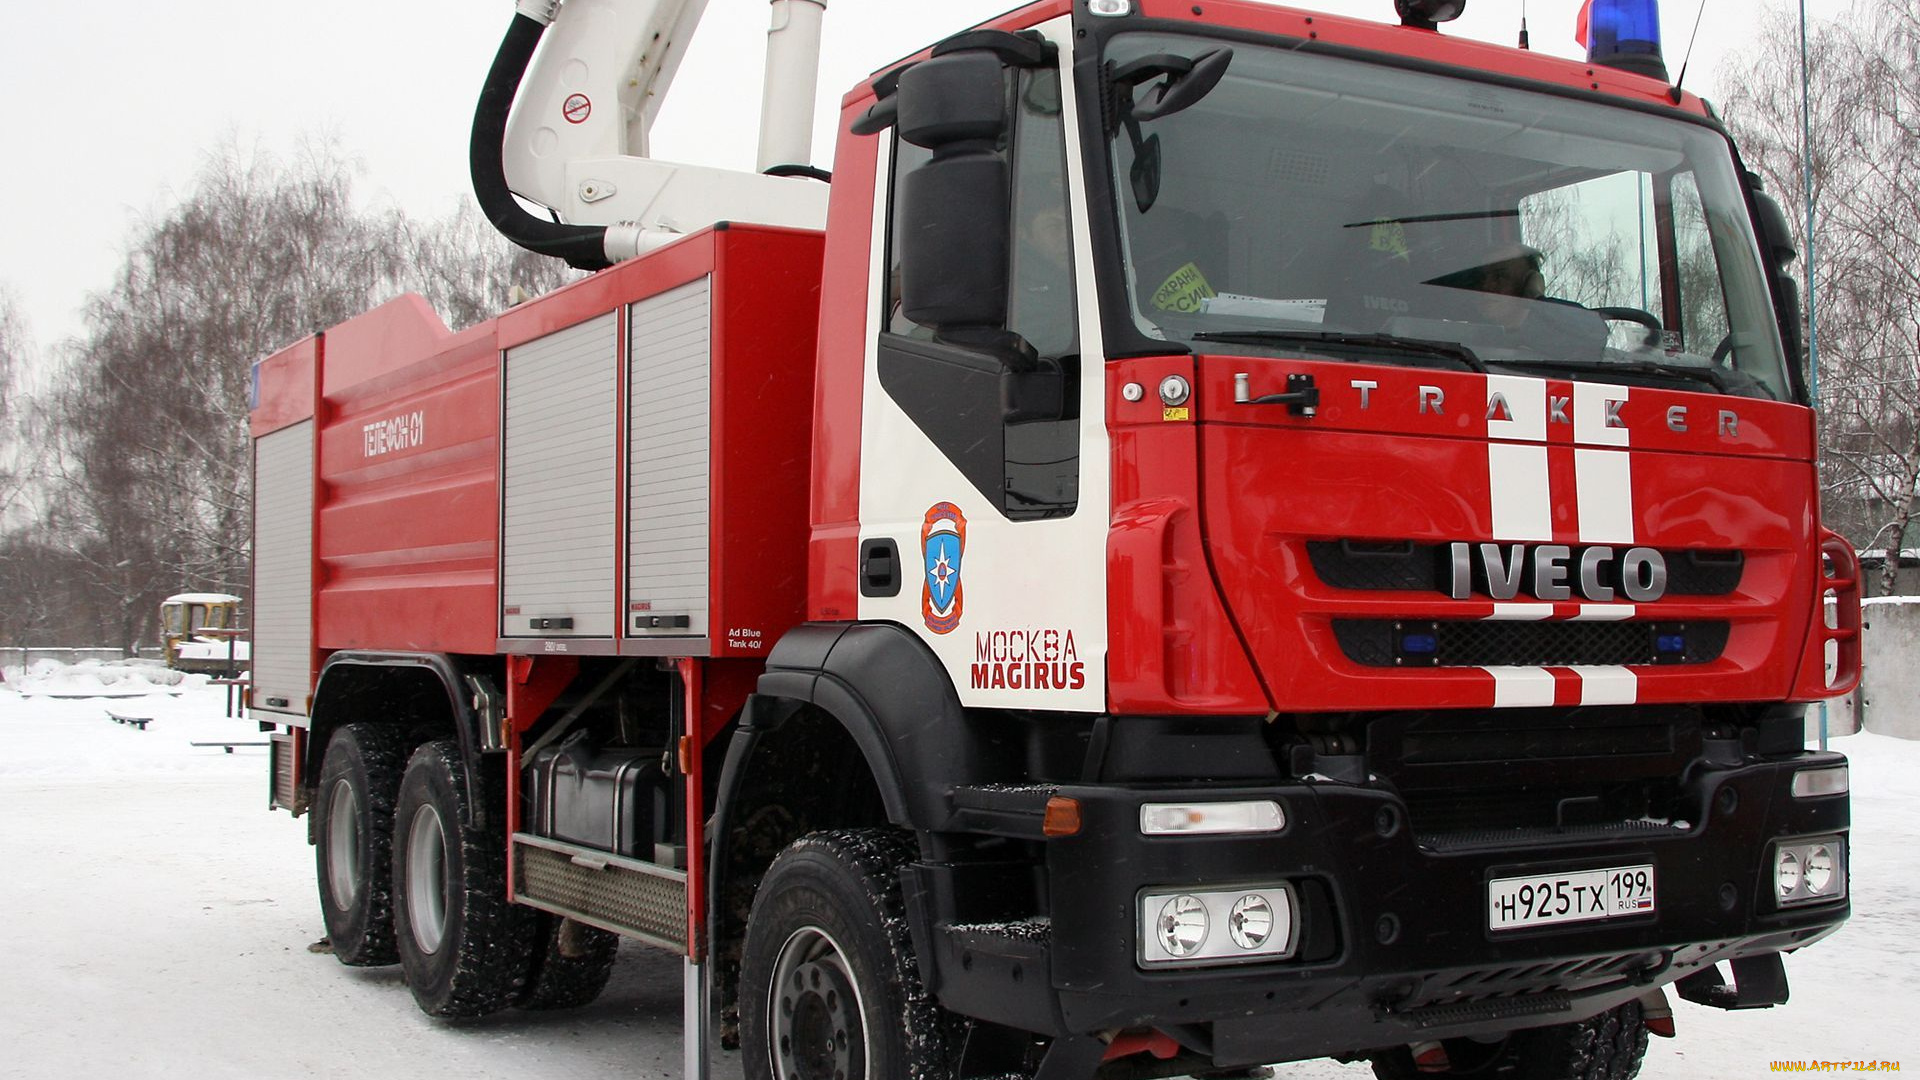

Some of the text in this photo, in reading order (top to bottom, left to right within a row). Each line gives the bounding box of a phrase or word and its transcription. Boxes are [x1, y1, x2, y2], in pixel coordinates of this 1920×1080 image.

[1157, 268, 1199, 303] ОХРАНА
[1351, 379, 1739, 437] TRAKKER
[363, 410, 423, 458] ТЕЛЕФОН 01
[1450, 542, 1667, 601] IVECO
[728, 628, 761, 637] Ad Blue
[728, 639, 747, 648] Tank
[975, 629, 1078, 663] МОСКВА
[970, 662, 1085, 690] MAGIRUS
[1501, 871, 1648, 922] Н925ТХ 199
[1618, 900, 1637, 910] RUS
